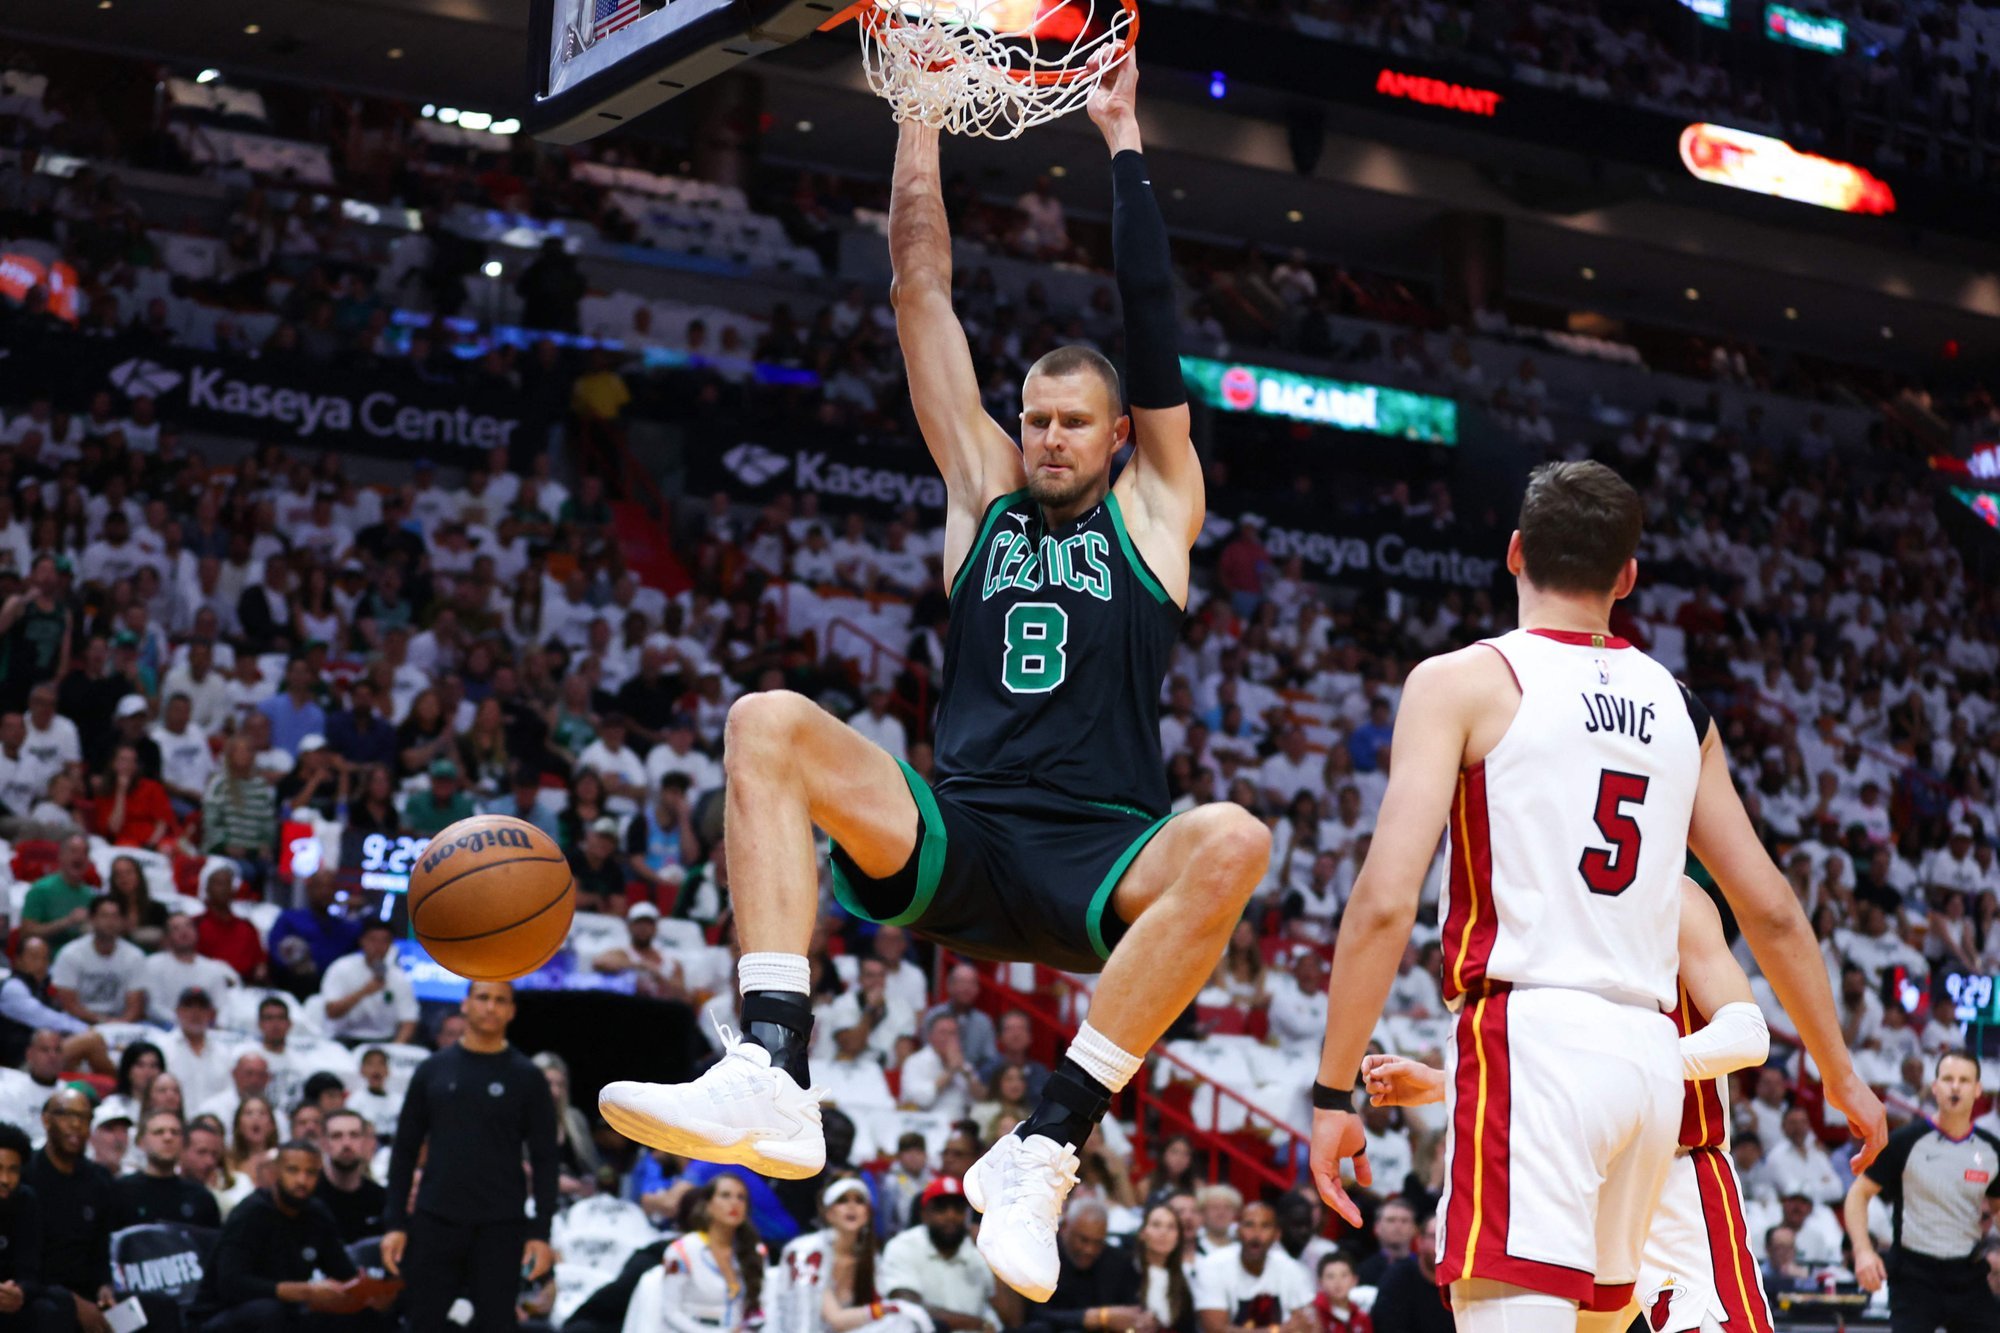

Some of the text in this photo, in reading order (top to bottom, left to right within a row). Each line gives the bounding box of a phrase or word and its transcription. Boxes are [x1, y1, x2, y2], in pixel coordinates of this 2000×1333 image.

[188, 366, 518, 449] Kaseya Center
[795, 450, 947, 511] Kaseya
[1266, 525, 1498, 587] aseya Center
[1002, 602, 1068, 693] 8
[1581, 692, 1655, 744] JOVIĆ
[423, 828, 533, 873] Wilson
[1578, 768, 1650, 896] 5
[124, 1251, 204, 1292] PLAYOFFS
